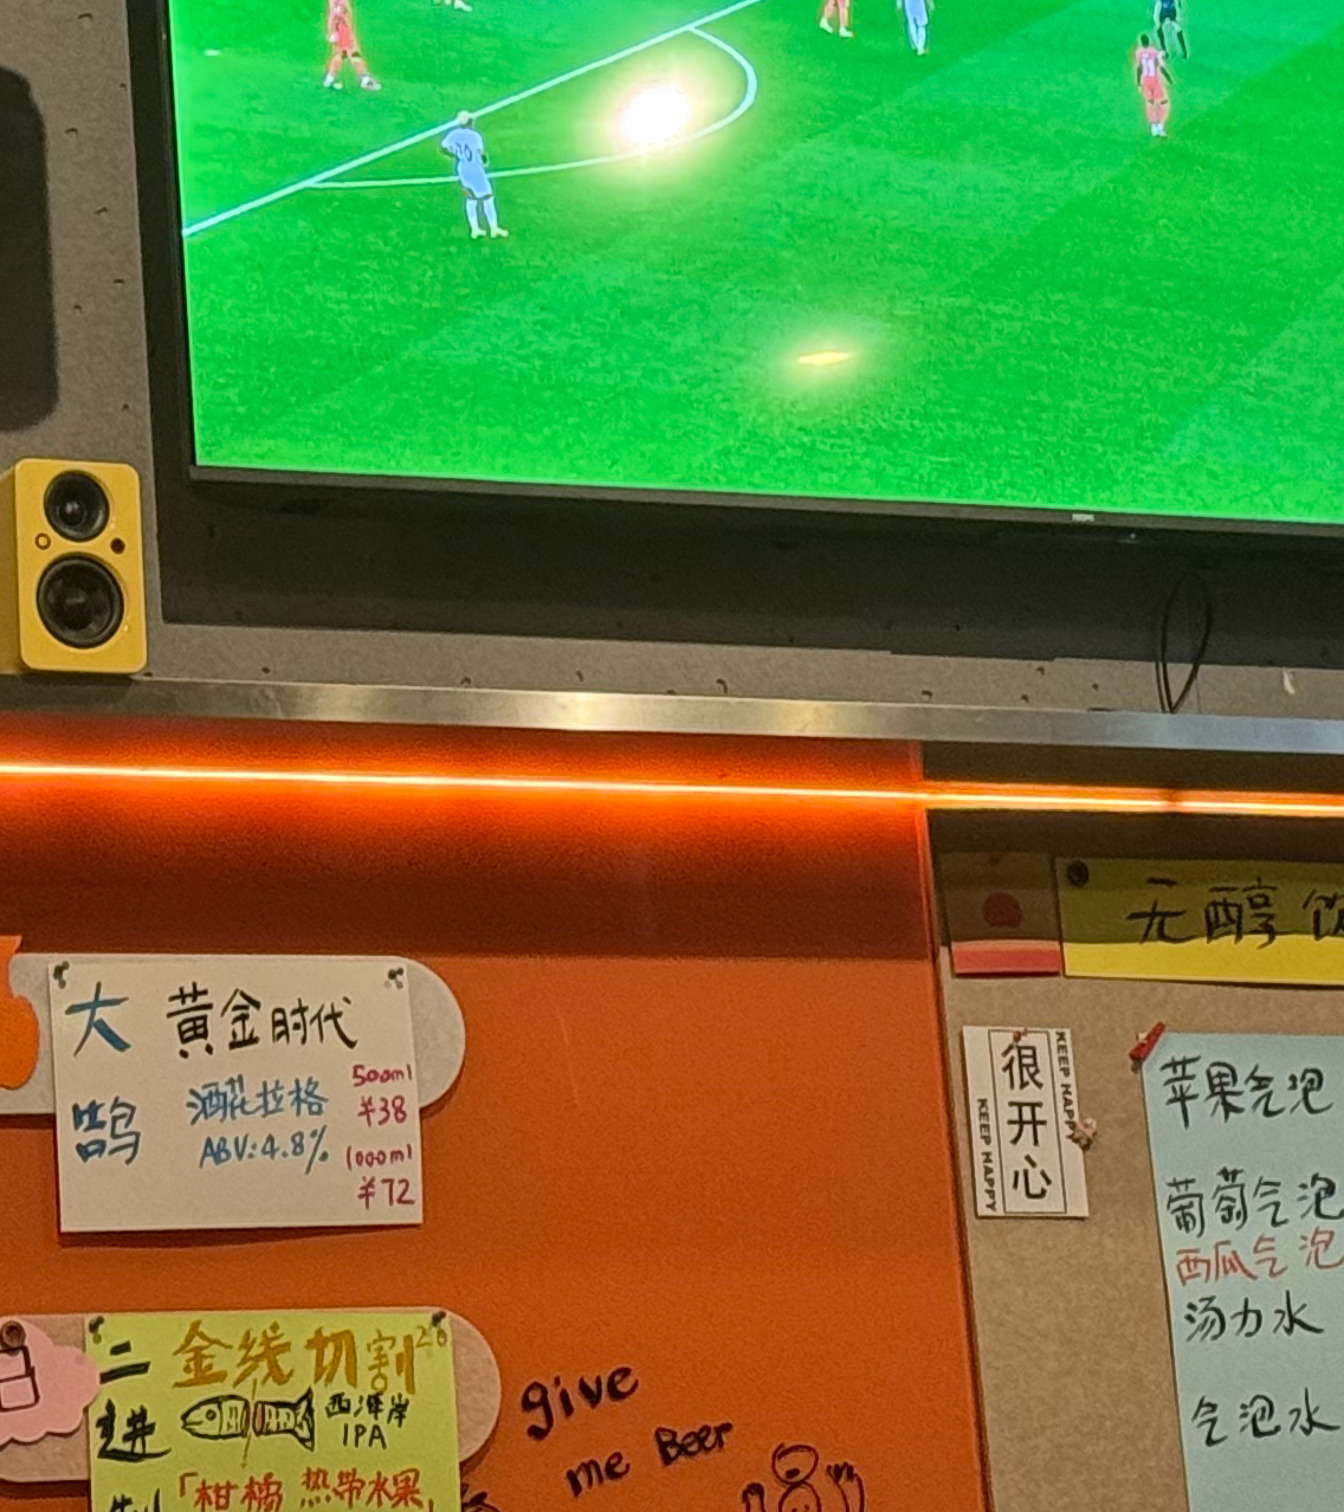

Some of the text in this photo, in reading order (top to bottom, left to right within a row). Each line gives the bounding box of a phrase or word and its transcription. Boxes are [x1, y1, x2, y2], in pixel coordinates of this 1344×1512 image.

[166, 981, 358, 1059] 黄金时代
[352, 1063, 413, 1087] 500ml
[1056, 1031, 1070, 1078] KEEP
[357, 1094, 408, 1127] ¥38
[1159, 1054, 1334, 1130] 苹果气泡
[1001, 1042, 1053, 1200] 很开心
[977, 1098, 997, 1212] KEEP HAPPY
[357, 1175, 416, 1210] ¥72
[1184, 1289, 1325, 1343] 汤力水
[521, 1366, 639, 1441] give
[1191, 1387, 1341, 1448] 气泡水
[342, 1424, 388, 1450] IPA
[566, 1452, 631, 1498] me
